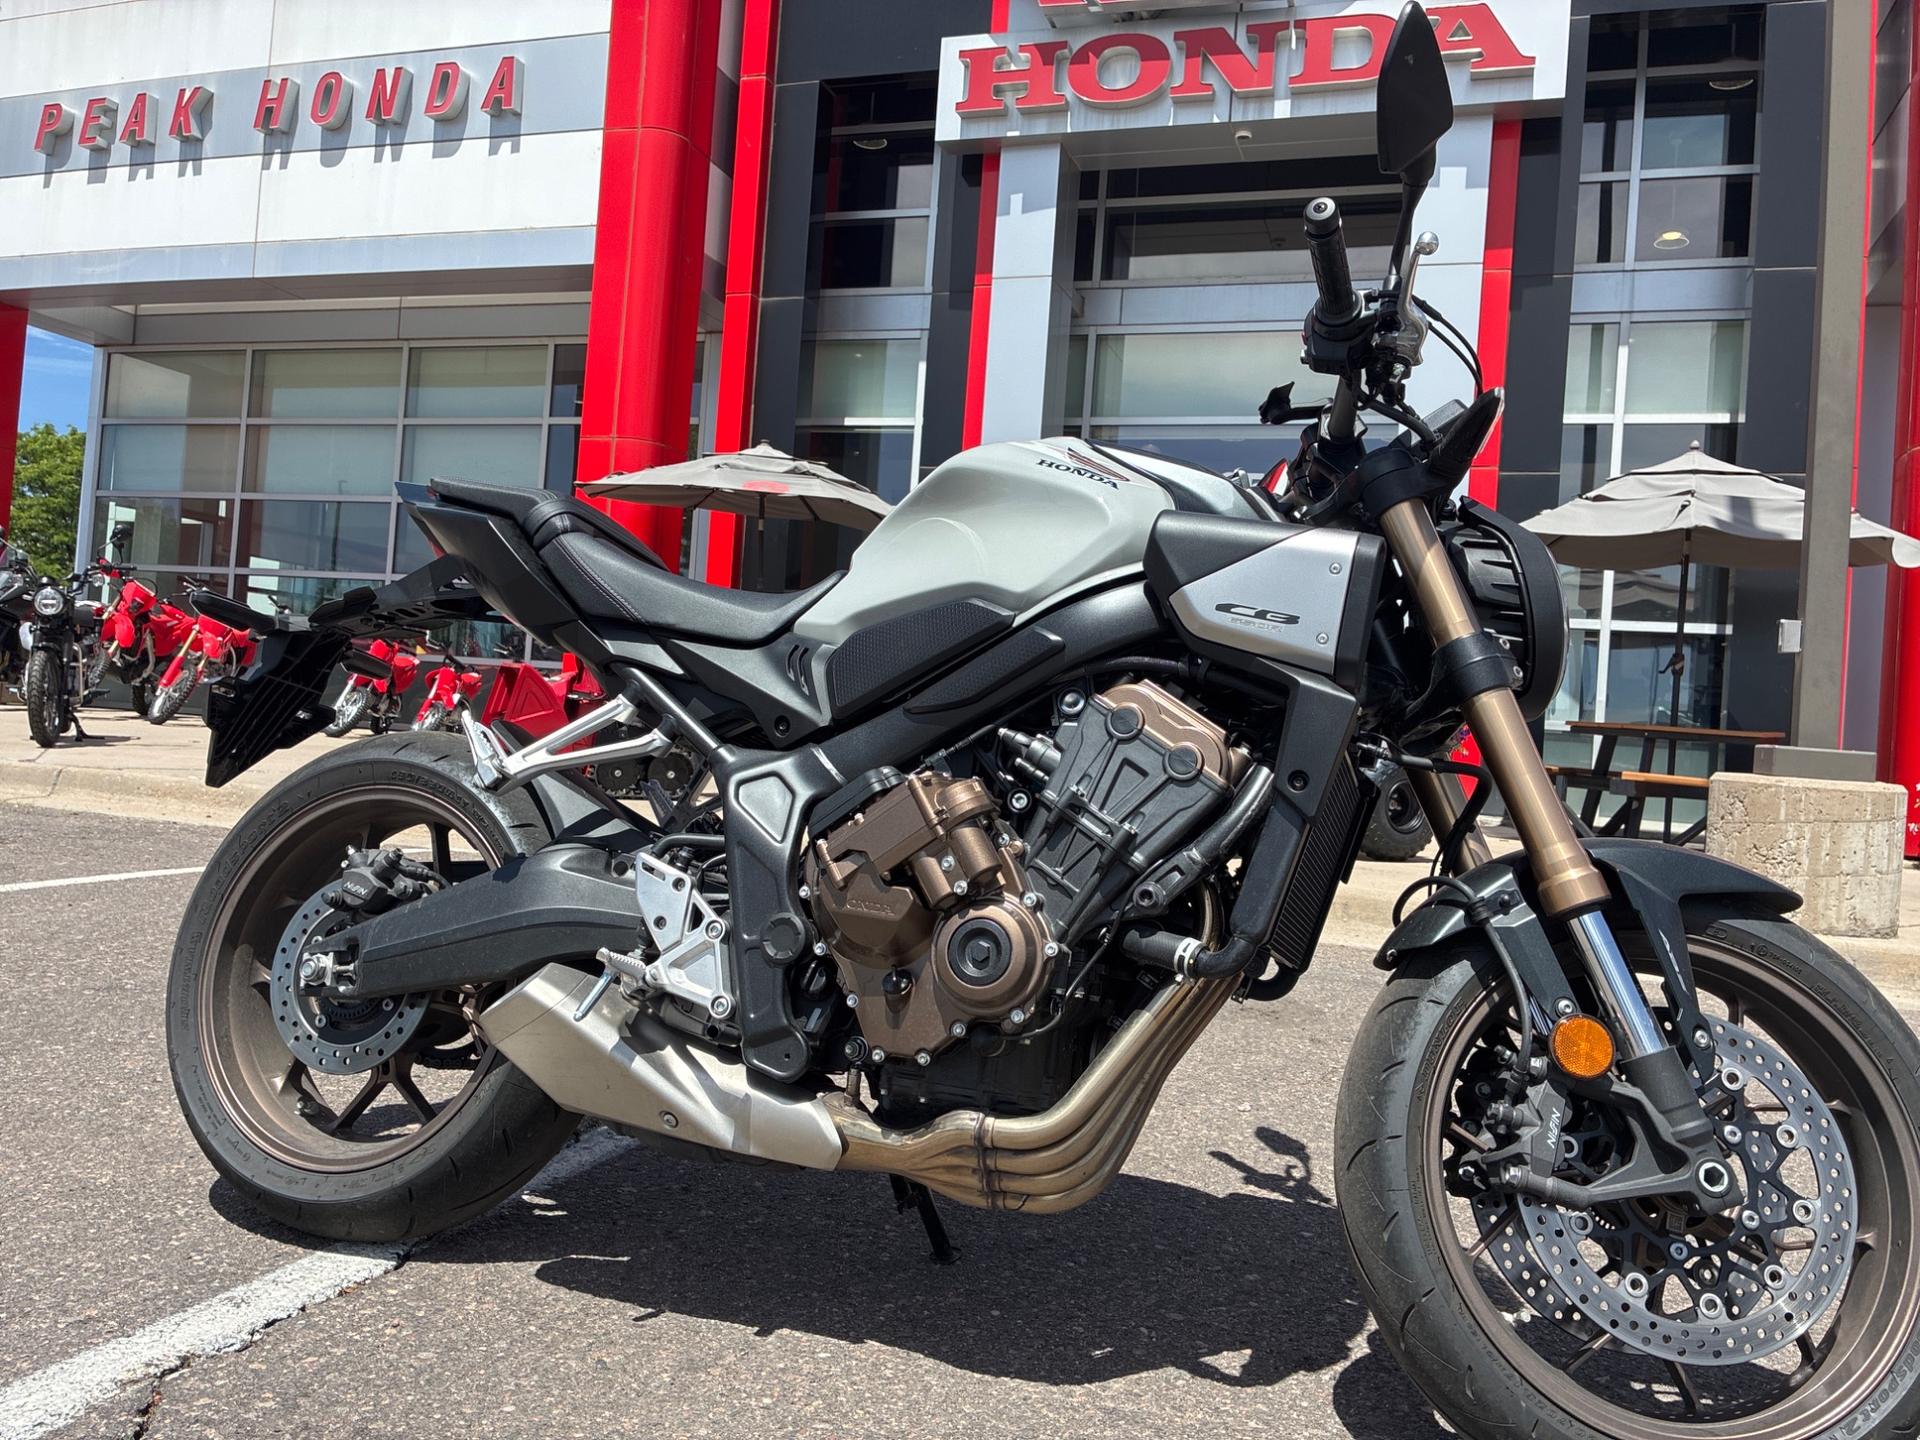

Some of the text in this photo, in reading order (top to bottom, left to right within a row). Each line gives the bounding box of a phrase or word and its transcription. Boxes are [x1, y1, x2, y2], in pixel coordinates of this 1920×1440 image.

[34, 55, 522, 154] PEAK HONDA
[955, 2, 1535, 114] HONDA
[1037, 458, 1120, 490] HONDA
